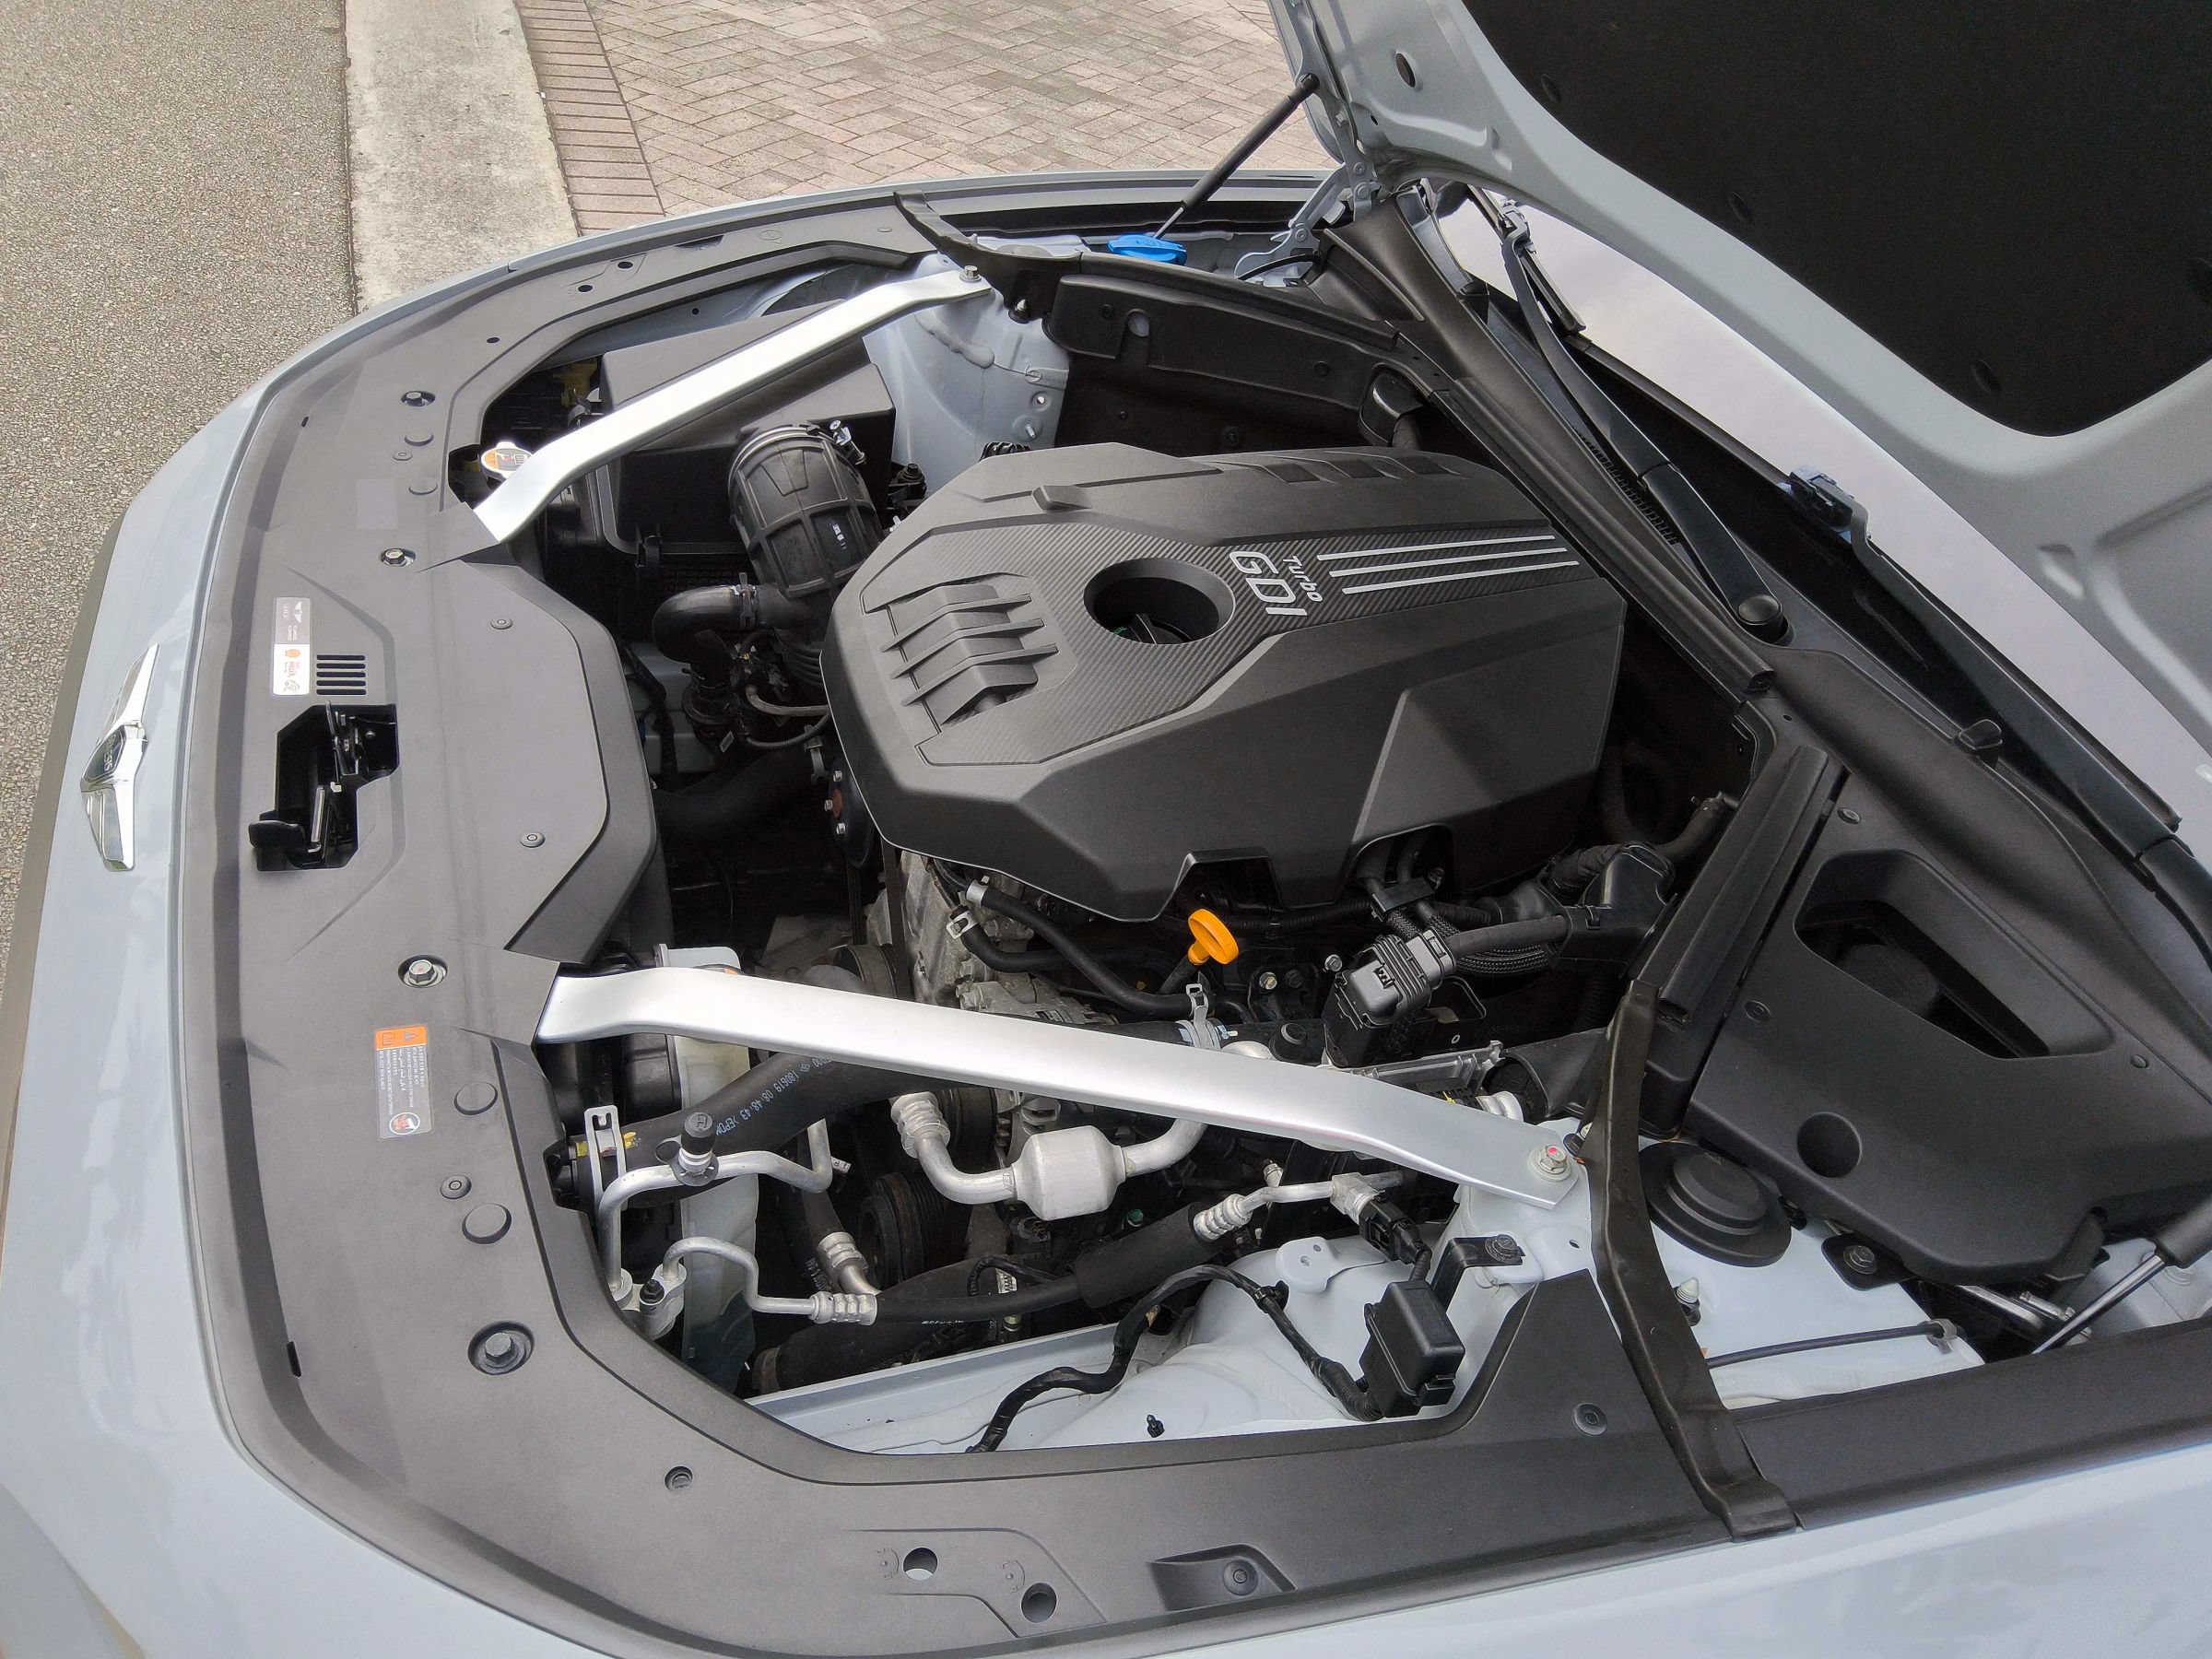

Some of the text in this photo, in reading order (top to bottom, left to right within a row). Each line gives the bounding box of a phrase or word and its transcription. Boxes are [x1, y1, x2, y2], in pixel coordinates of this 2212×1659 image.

[1230, 551, 1308, 616] GDI
[1282, 555, 1323, 602] Turbo
[773, 1070, 799, 1093] 180619
